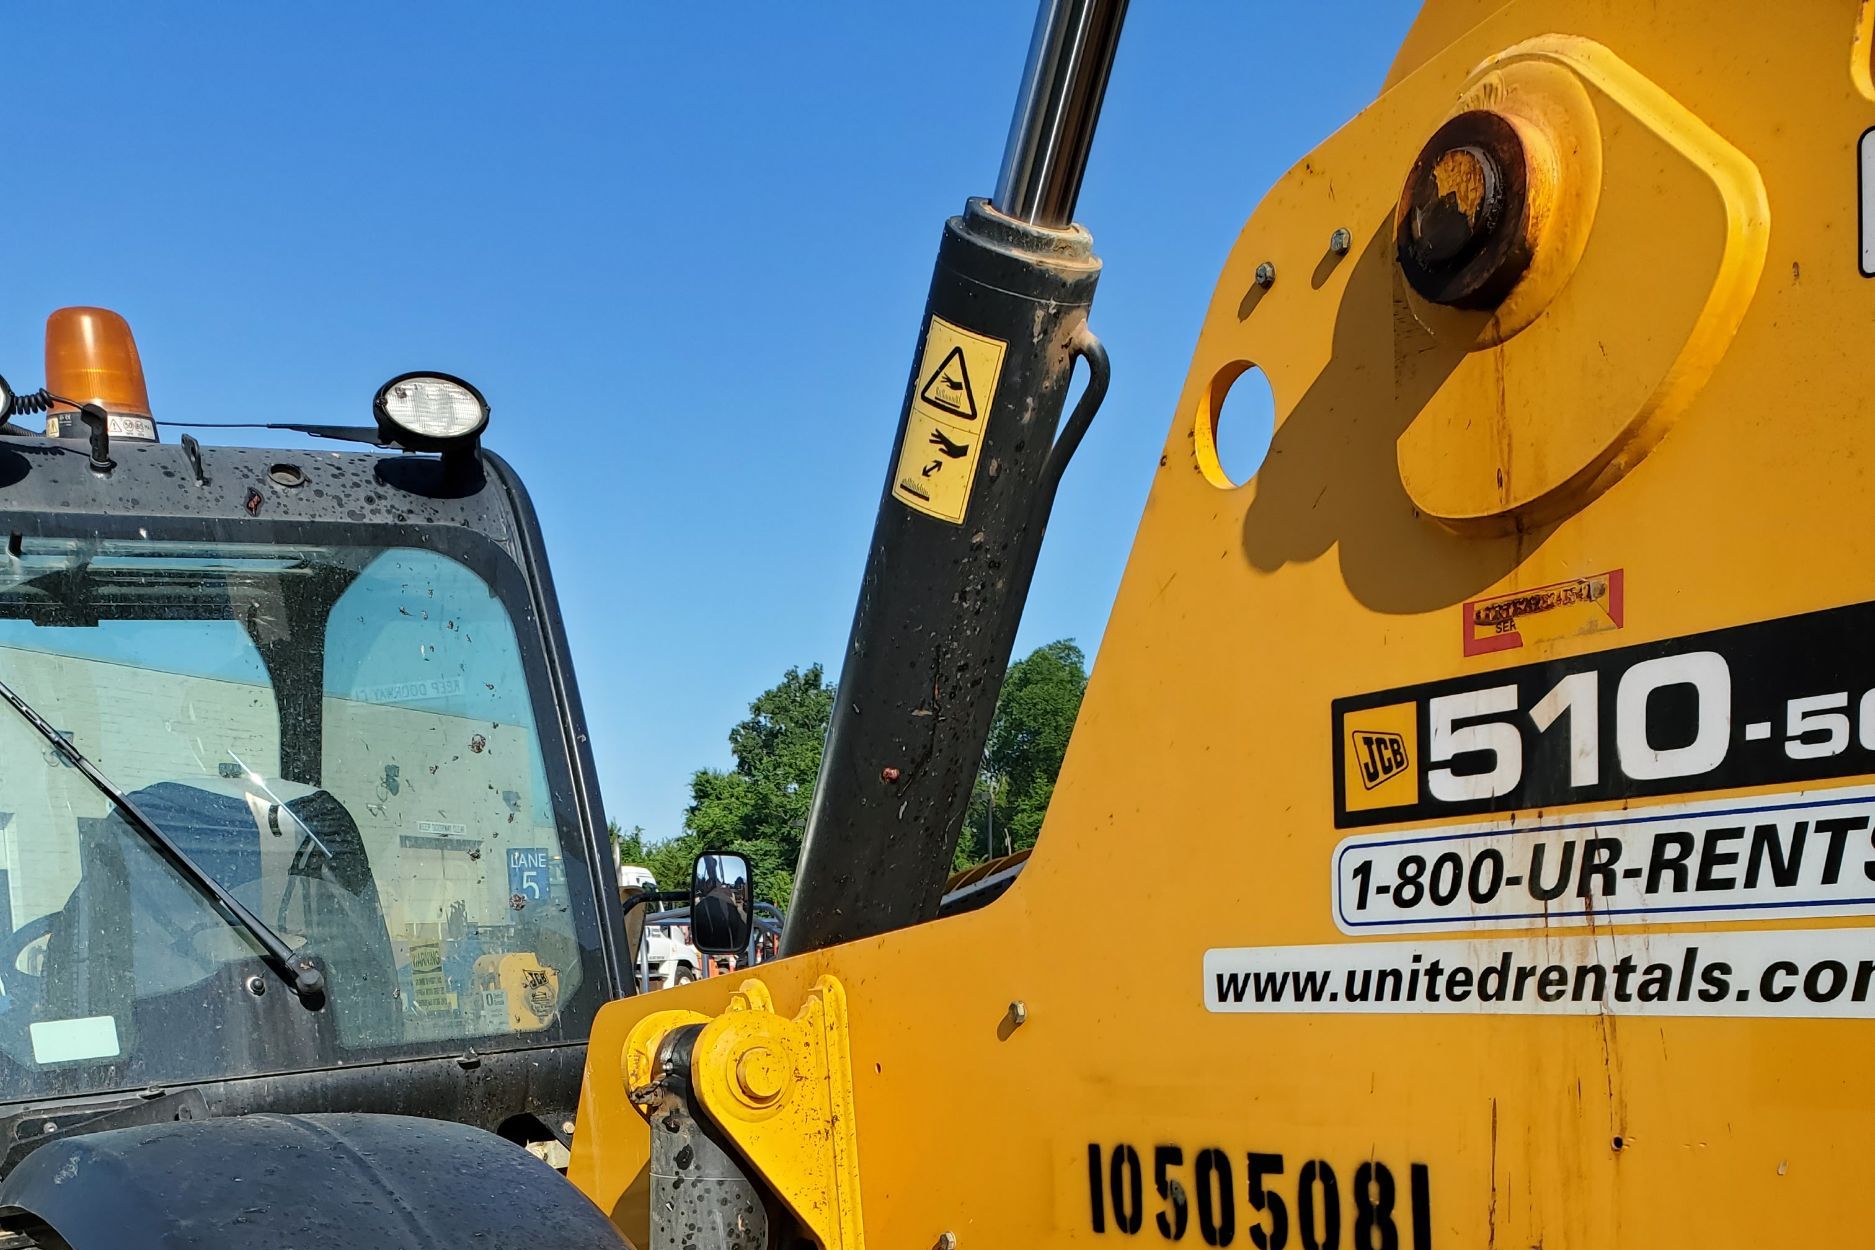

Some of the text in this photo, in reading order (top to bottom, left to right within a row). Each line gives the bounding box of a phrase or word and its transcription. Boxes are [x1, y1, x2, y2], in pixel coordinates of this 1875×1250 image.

[1361, 651, 1875, 801] JCB 510-5
[510, 852, 547, 868] LANE
[1351, 814, 1875, 911] 1-800-UR-RENT
[522, 871, 540, 899] 5
[528, 972, 548, 987] JCB
